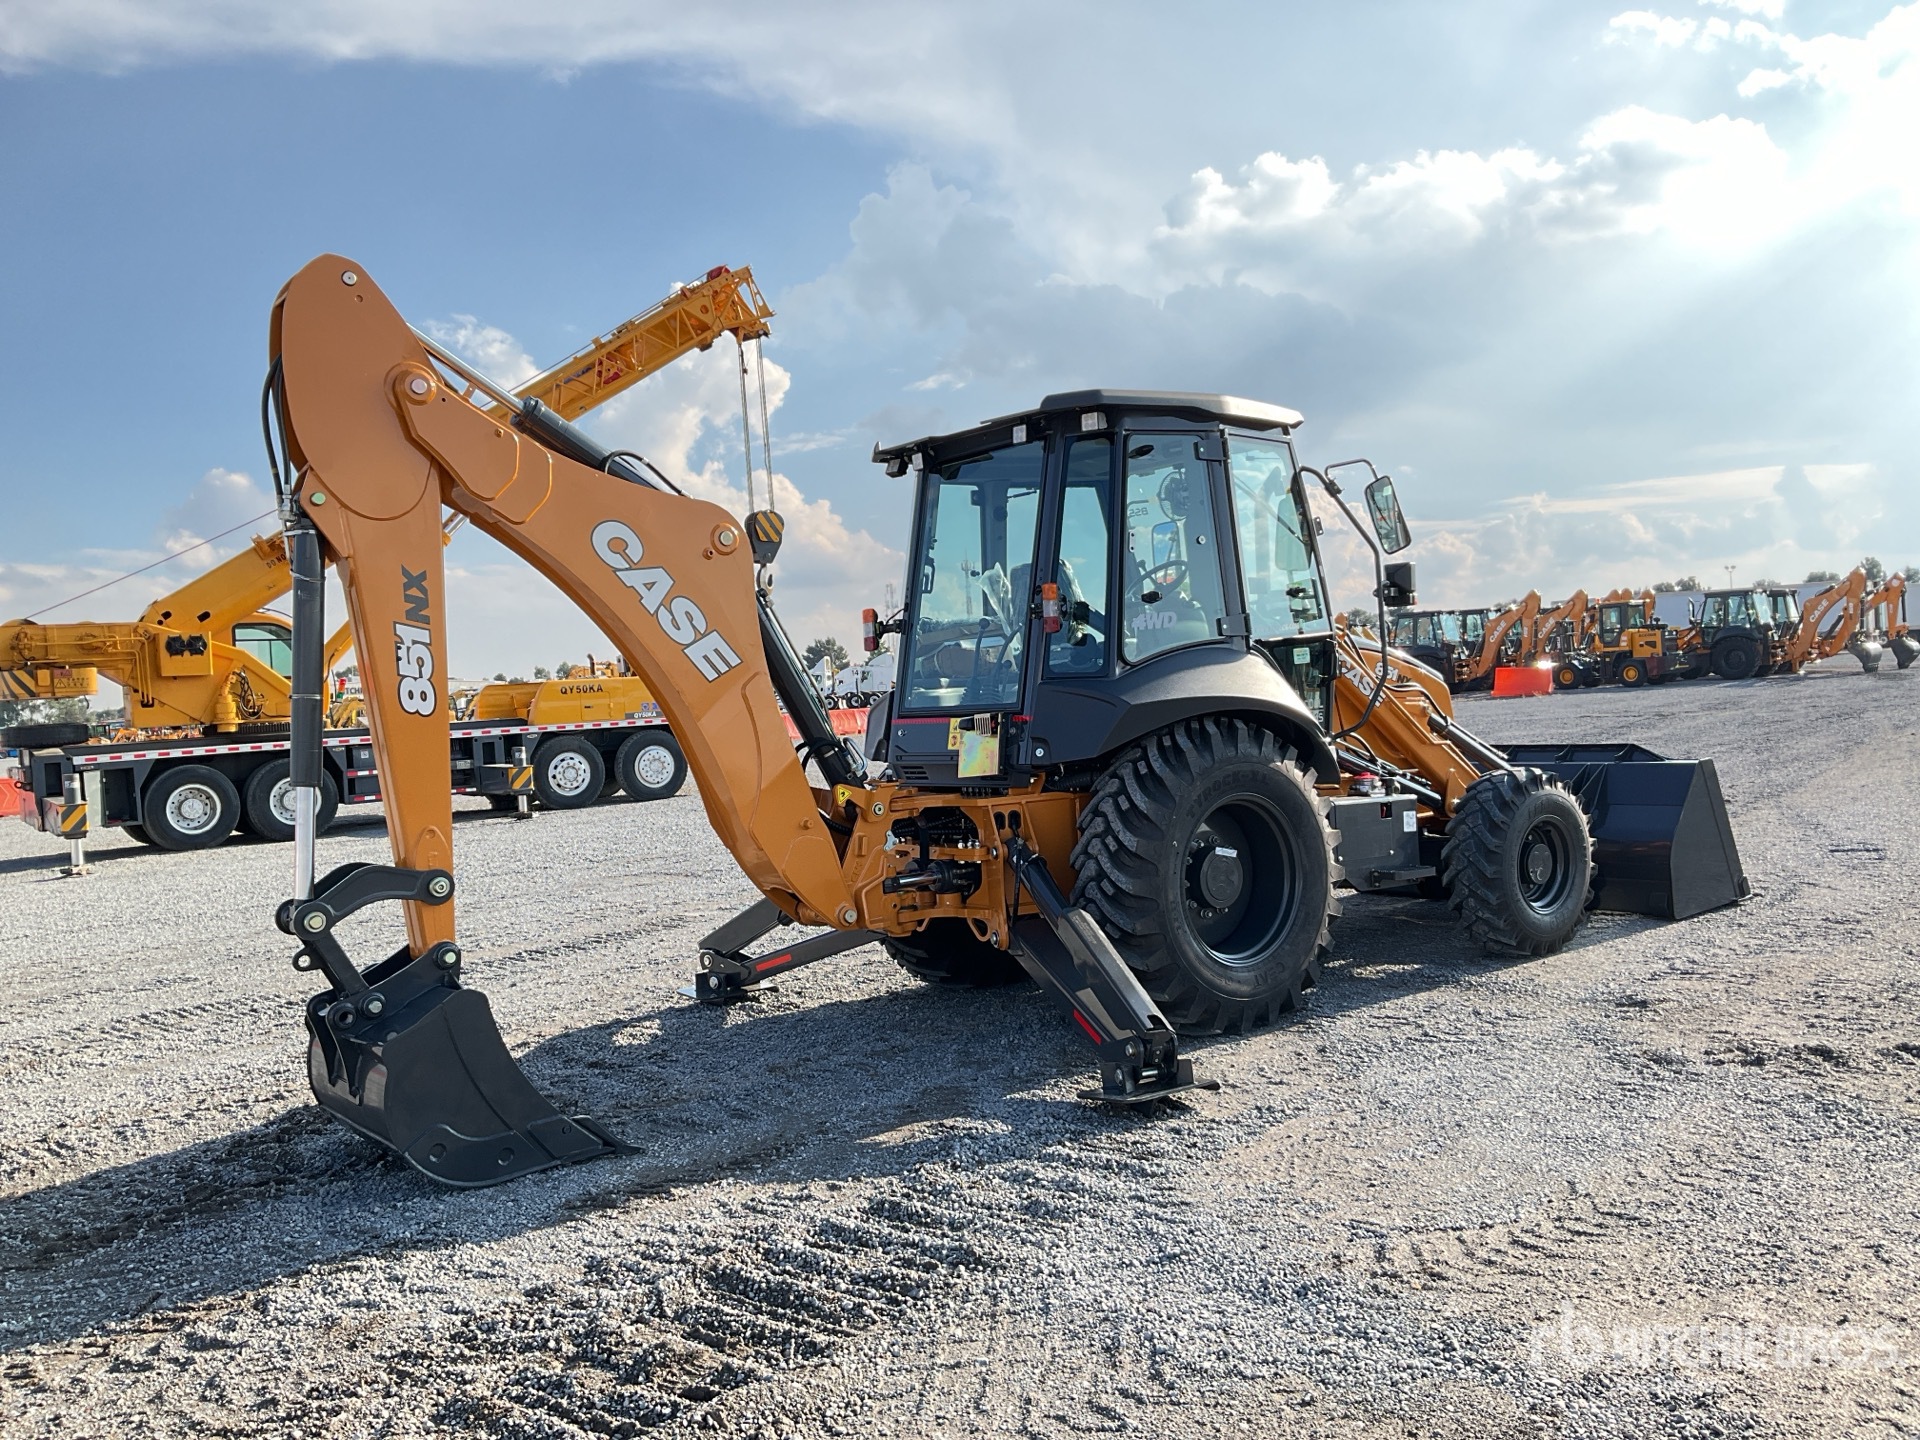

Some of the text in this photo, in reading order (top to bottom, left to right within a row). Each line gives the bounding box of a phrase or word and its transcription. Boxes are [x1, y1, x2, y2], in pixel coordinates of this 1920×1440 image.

[591, 519, 743, 683] CASE
[1809, 599, 1829, 622] CASE
[1489, 620, 1506, 642] CASE
[1538, 617, 1556, 638] CASE
[560, 684, 604, 695] QY50KA
[634, 711, 657, 719] QY50KA
